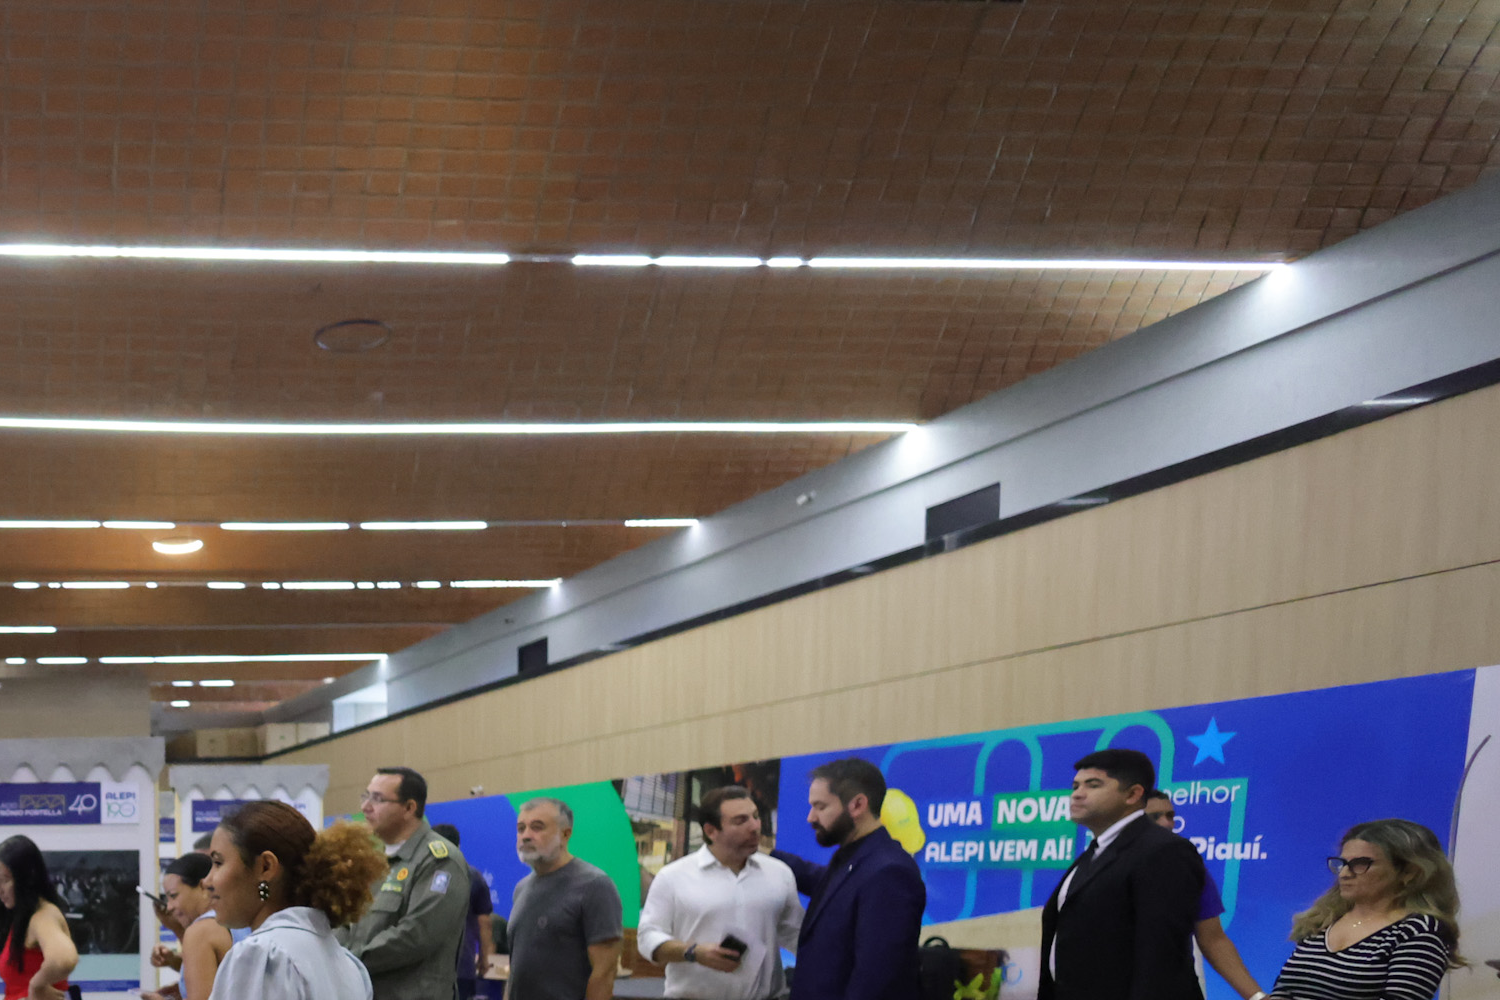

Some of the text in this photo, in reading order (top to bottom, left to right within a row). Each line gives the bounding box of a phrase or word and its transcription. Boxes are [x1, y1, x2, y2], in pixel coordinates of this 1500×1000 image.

[68, 793, 97, 815] 40
[105, 791, 136, 800] ALEPI
[928, 795, 1072, 828] UMA NOVA
[925, 841, 985, 863] ALEPI
[989, 839, 1038, 861] VEM
[1041, 835, 1073, 861] AÍ!
[1189, 834, 1267, 860] Piauí.
